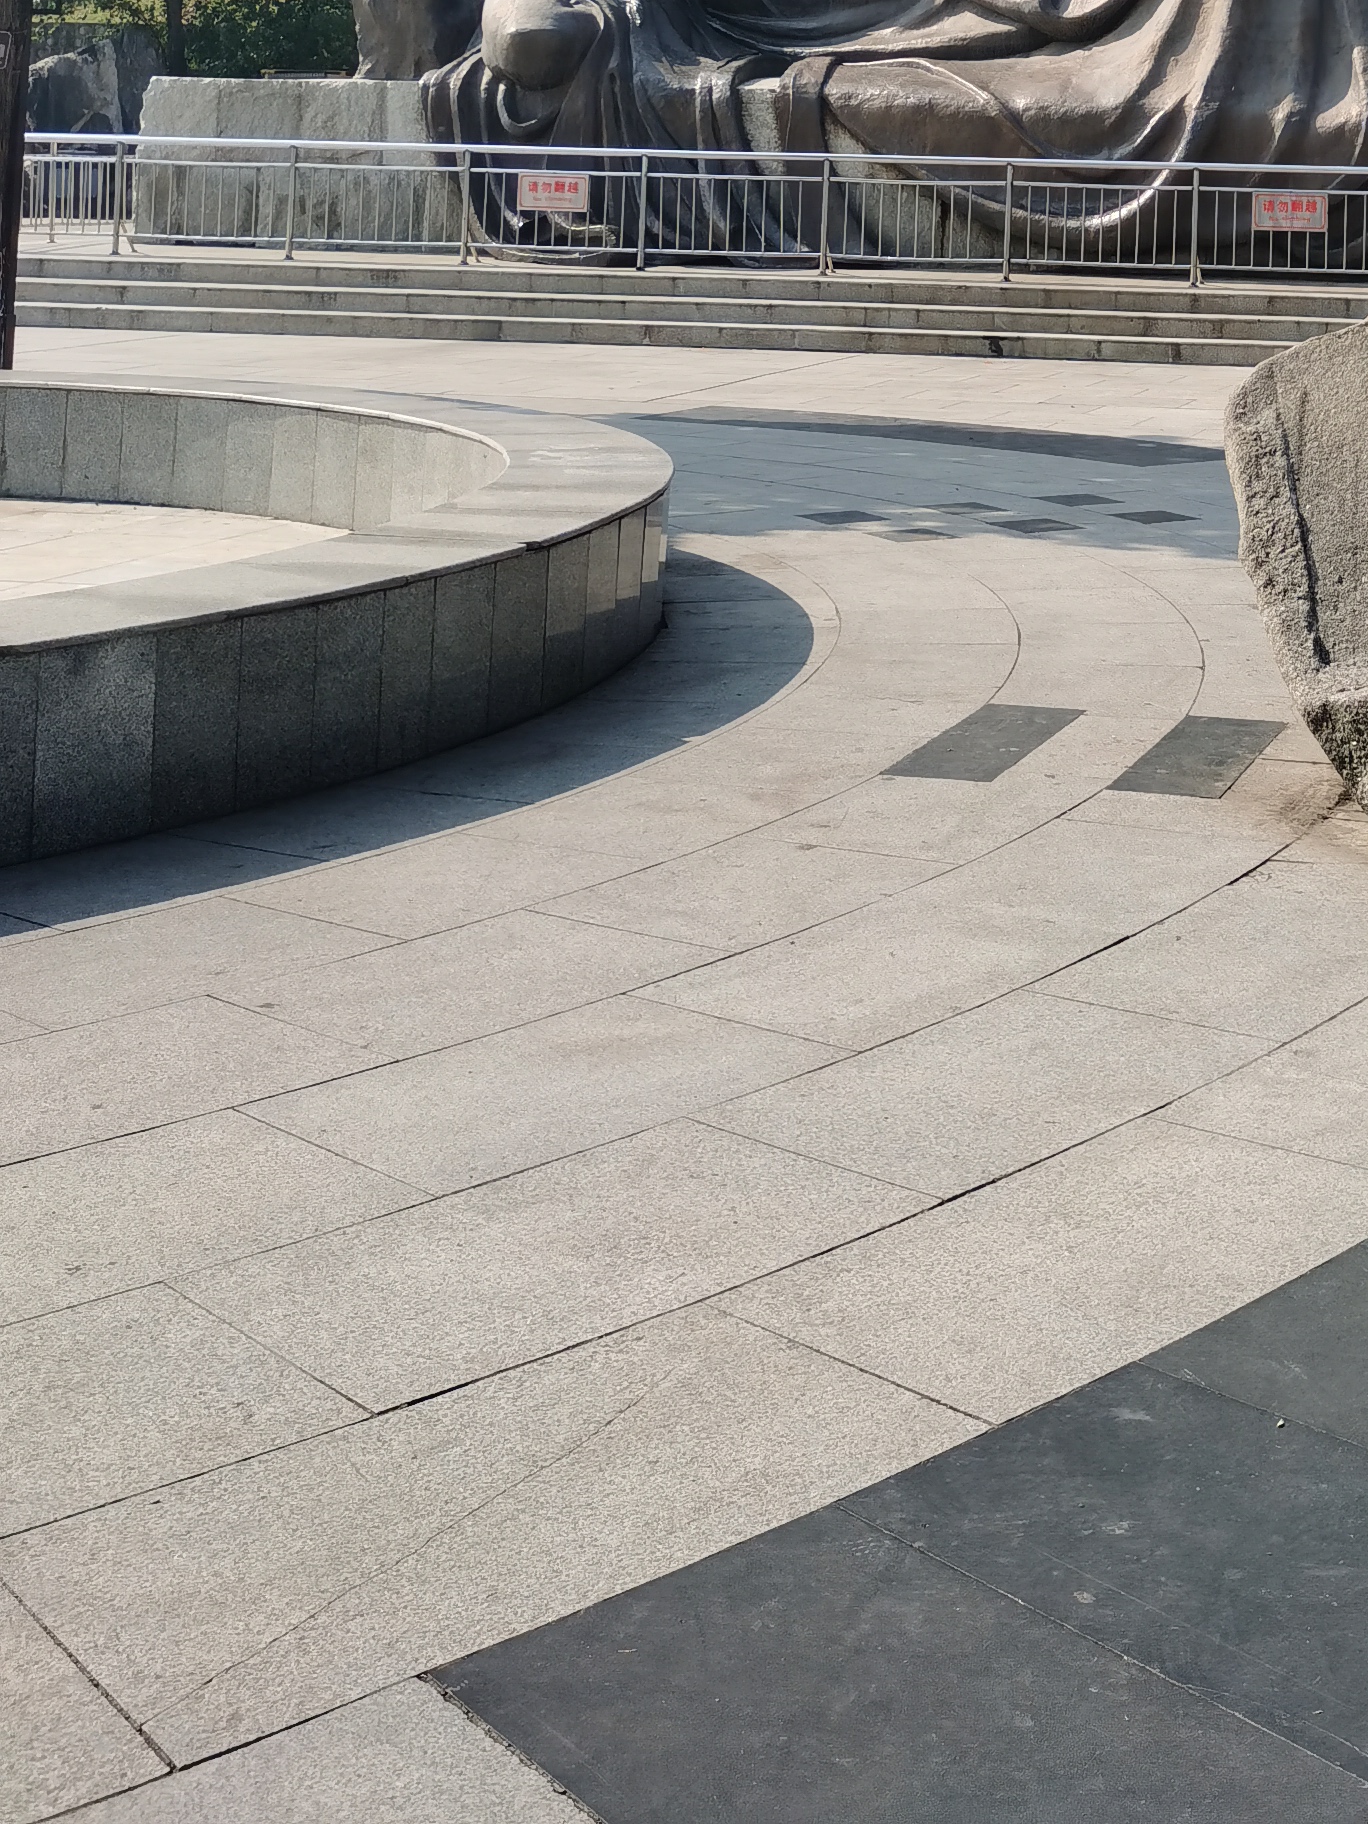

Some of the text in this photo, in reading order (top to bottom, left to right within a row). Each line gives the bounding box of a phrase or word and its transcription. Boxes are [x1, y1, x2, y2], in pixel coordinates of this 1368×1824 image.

[528, 180, 579, 194] 请勿翻越
[1263, 199, 1317, 213] 请勿翻越
